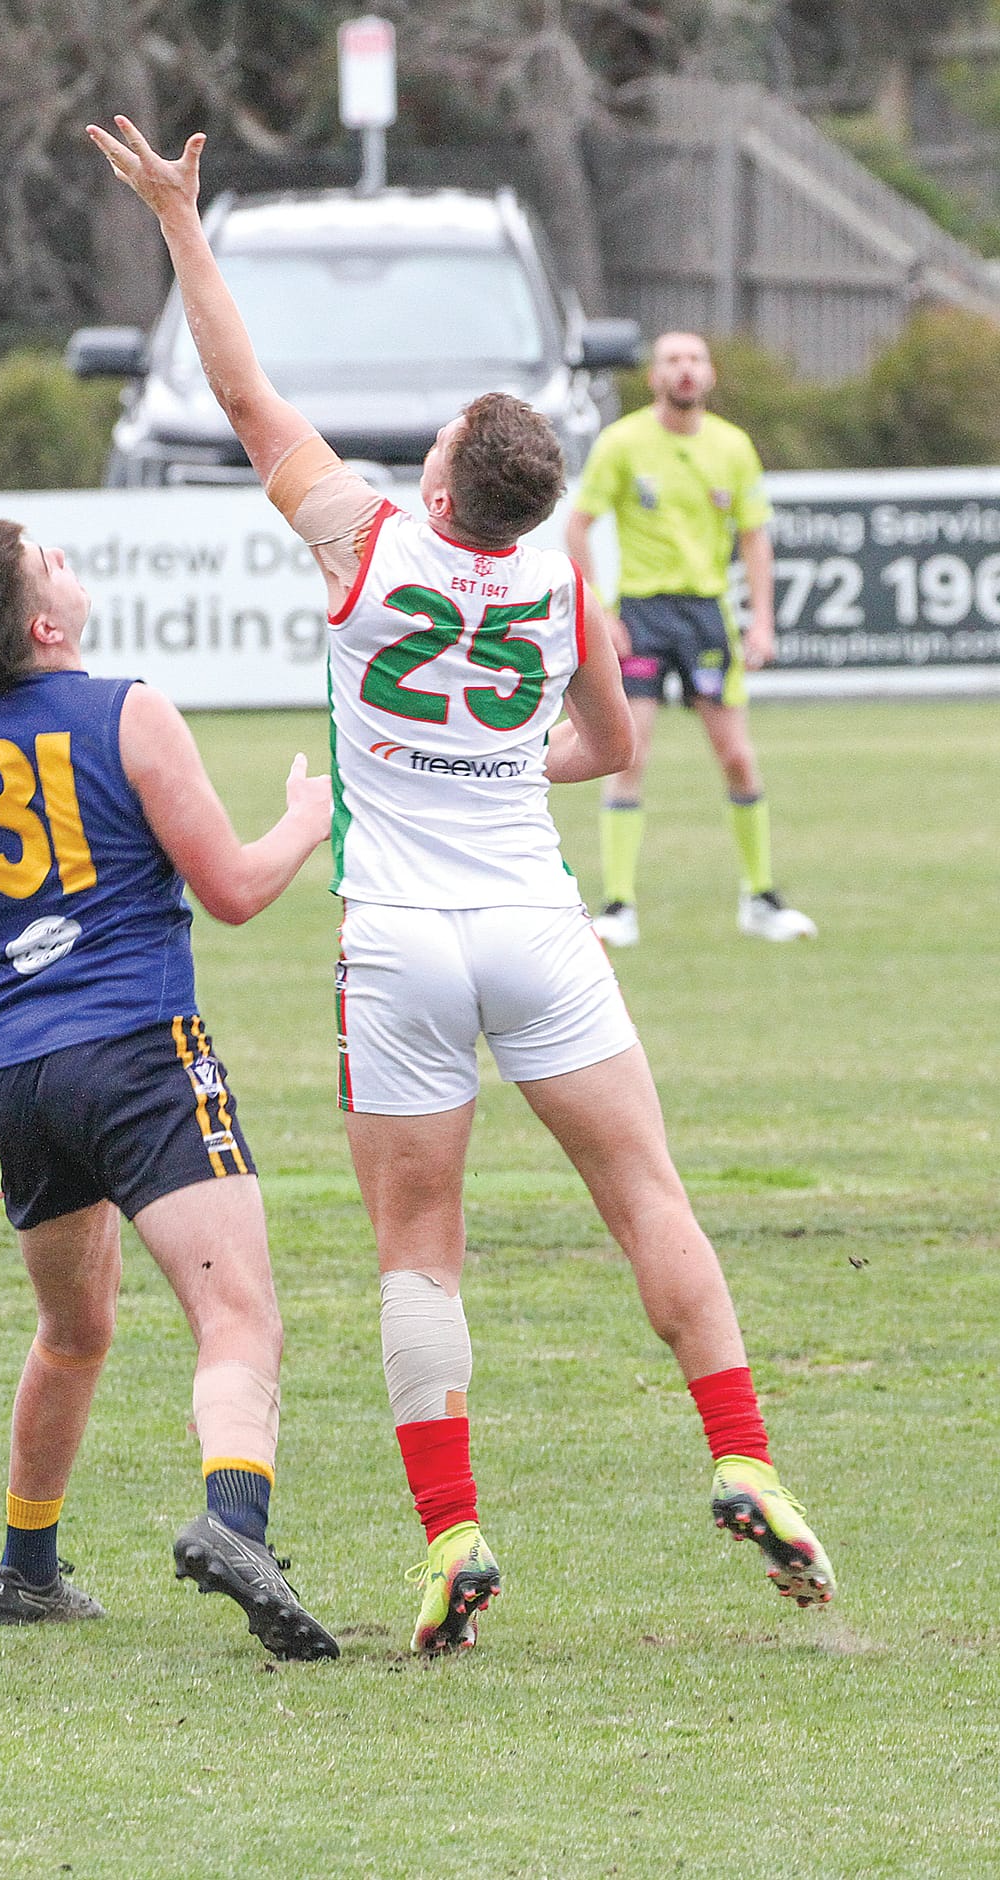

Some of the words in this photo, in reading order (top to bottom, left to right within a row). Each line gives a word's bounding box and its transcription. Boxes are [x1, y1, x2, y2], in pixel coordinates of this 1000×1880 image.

[450, 576, 477, 594] EST
[481, 583, 509, 599] 1947
[360, 584, 552, 731] 25
[409, 751, 528, 778] freeway
